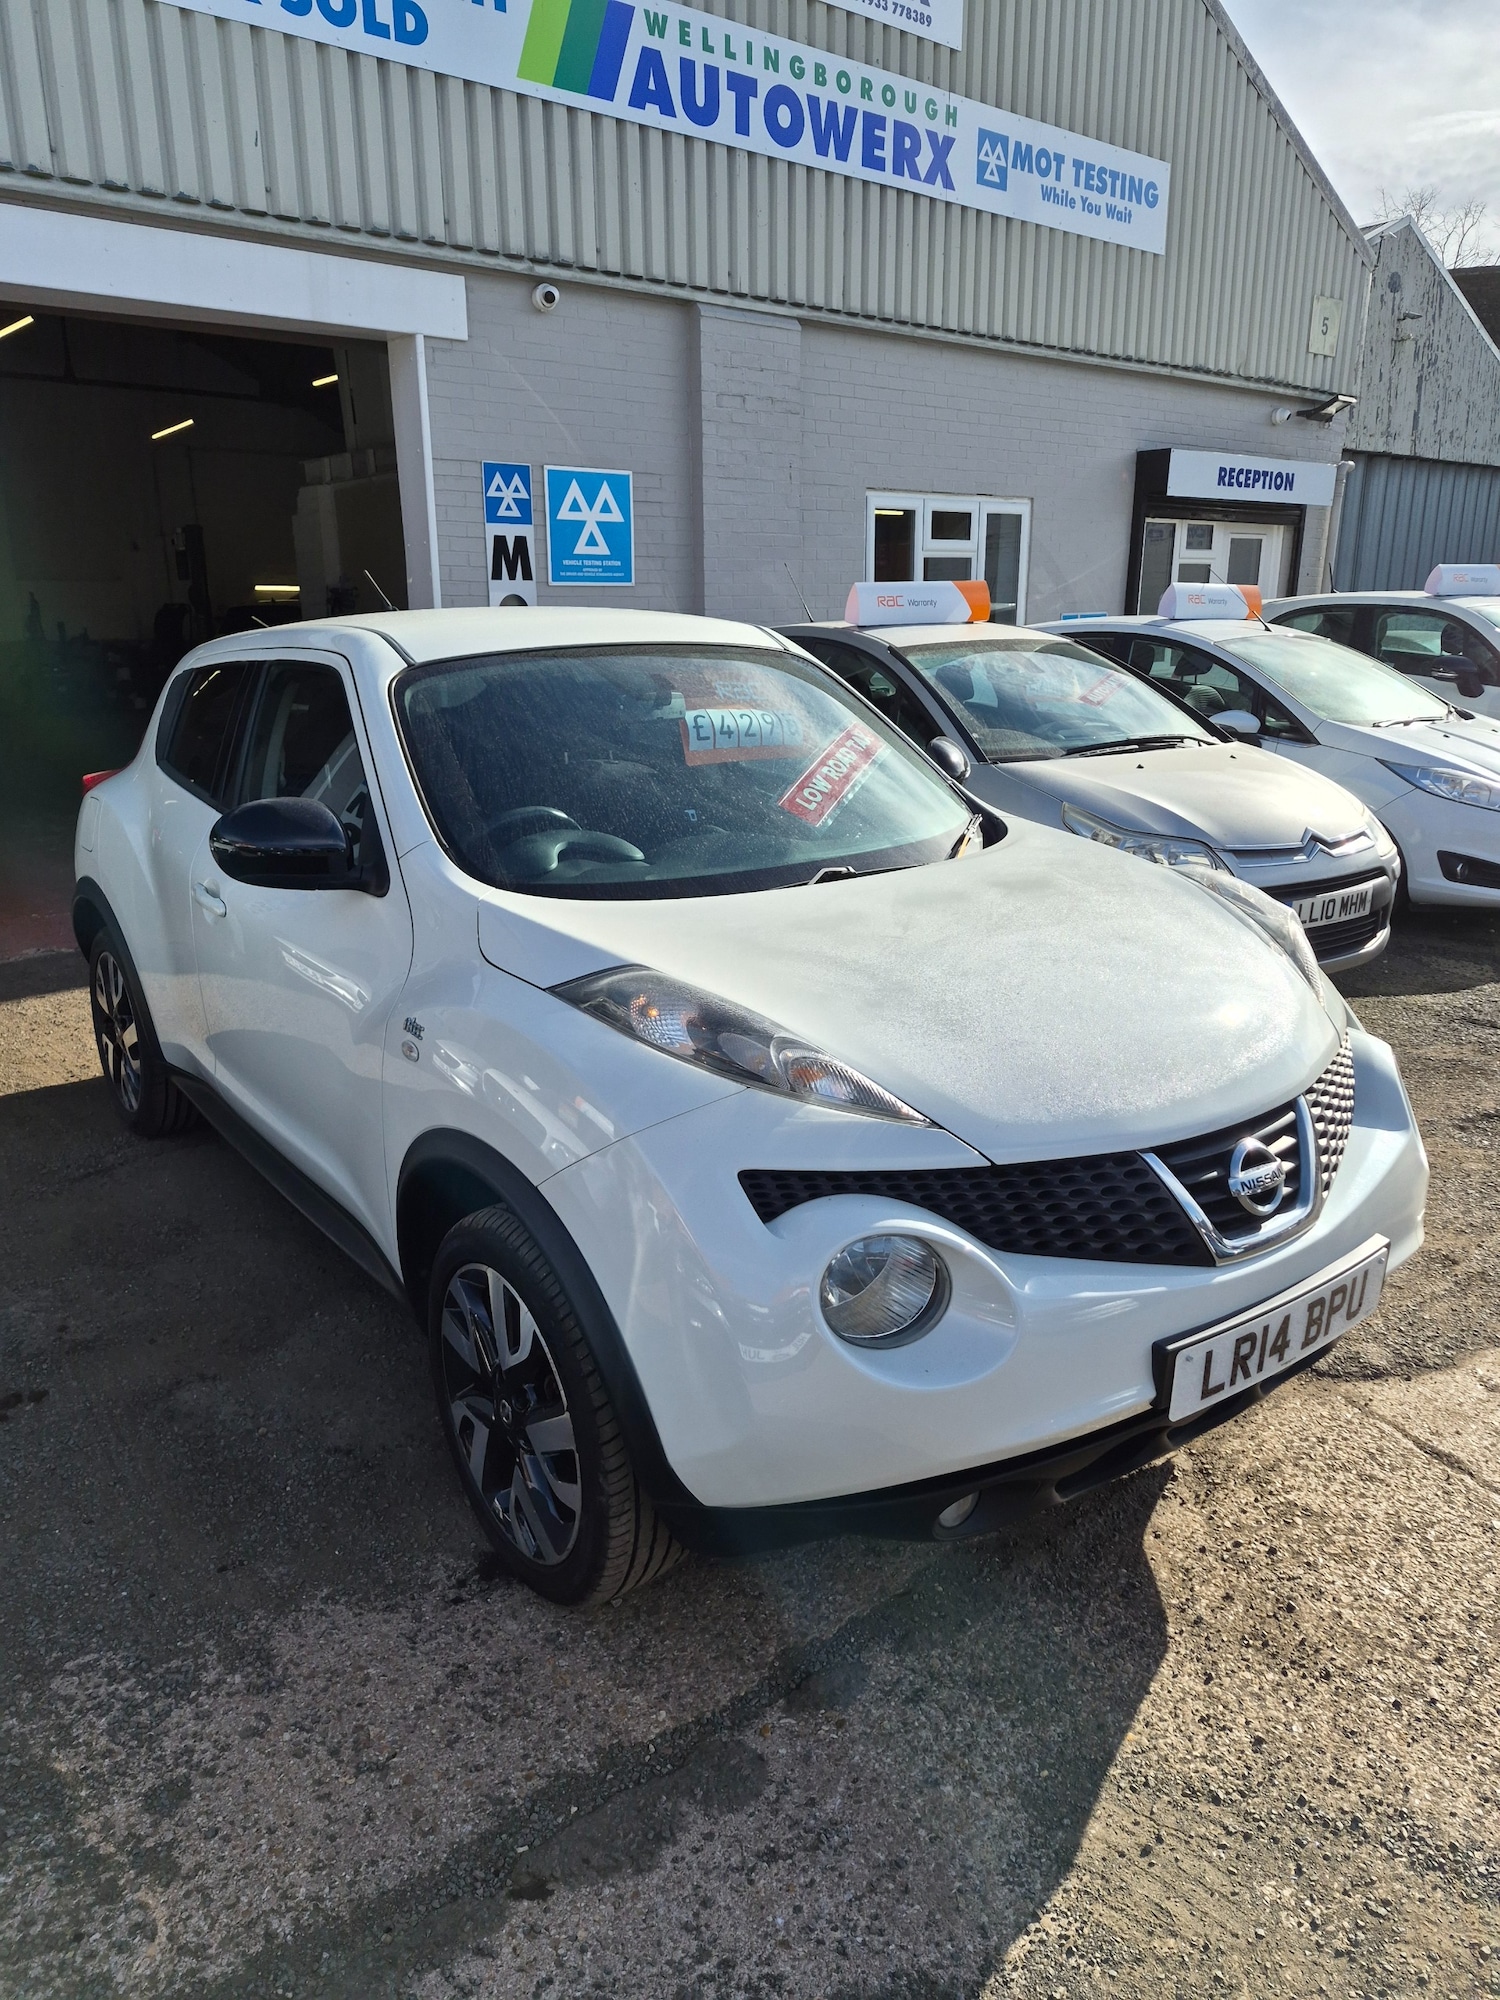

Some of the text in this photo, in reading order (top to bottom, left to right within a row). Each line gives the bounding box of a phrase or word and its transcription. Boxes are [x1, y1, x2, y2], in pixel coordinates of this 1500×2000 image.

[892, 2, 932, 27] 778389
[643, 8, 957, 127] WELLINGBOROUGH
[628, 45, 956, 191] AUTOWERX
[1011, 140, 1159, 209] MOT TESTING
[1041, 184, 1133, 224] While You Wait
[1321, 316, 1329, 336] 5
[1217, 466, 1295, 492] RECEPTION
[907, 598, 938, 608] Warranty
[1208, 598, 1228, 606] Warranty
[796, 728, 873, 811] LOW ROAD TAX
[1299, 890, 1369, 924] LL10 MHM
[1240, 1167, 1284, 1192] NISSAN
[1200, 1269, 1369, 1401] LR14 BPU
